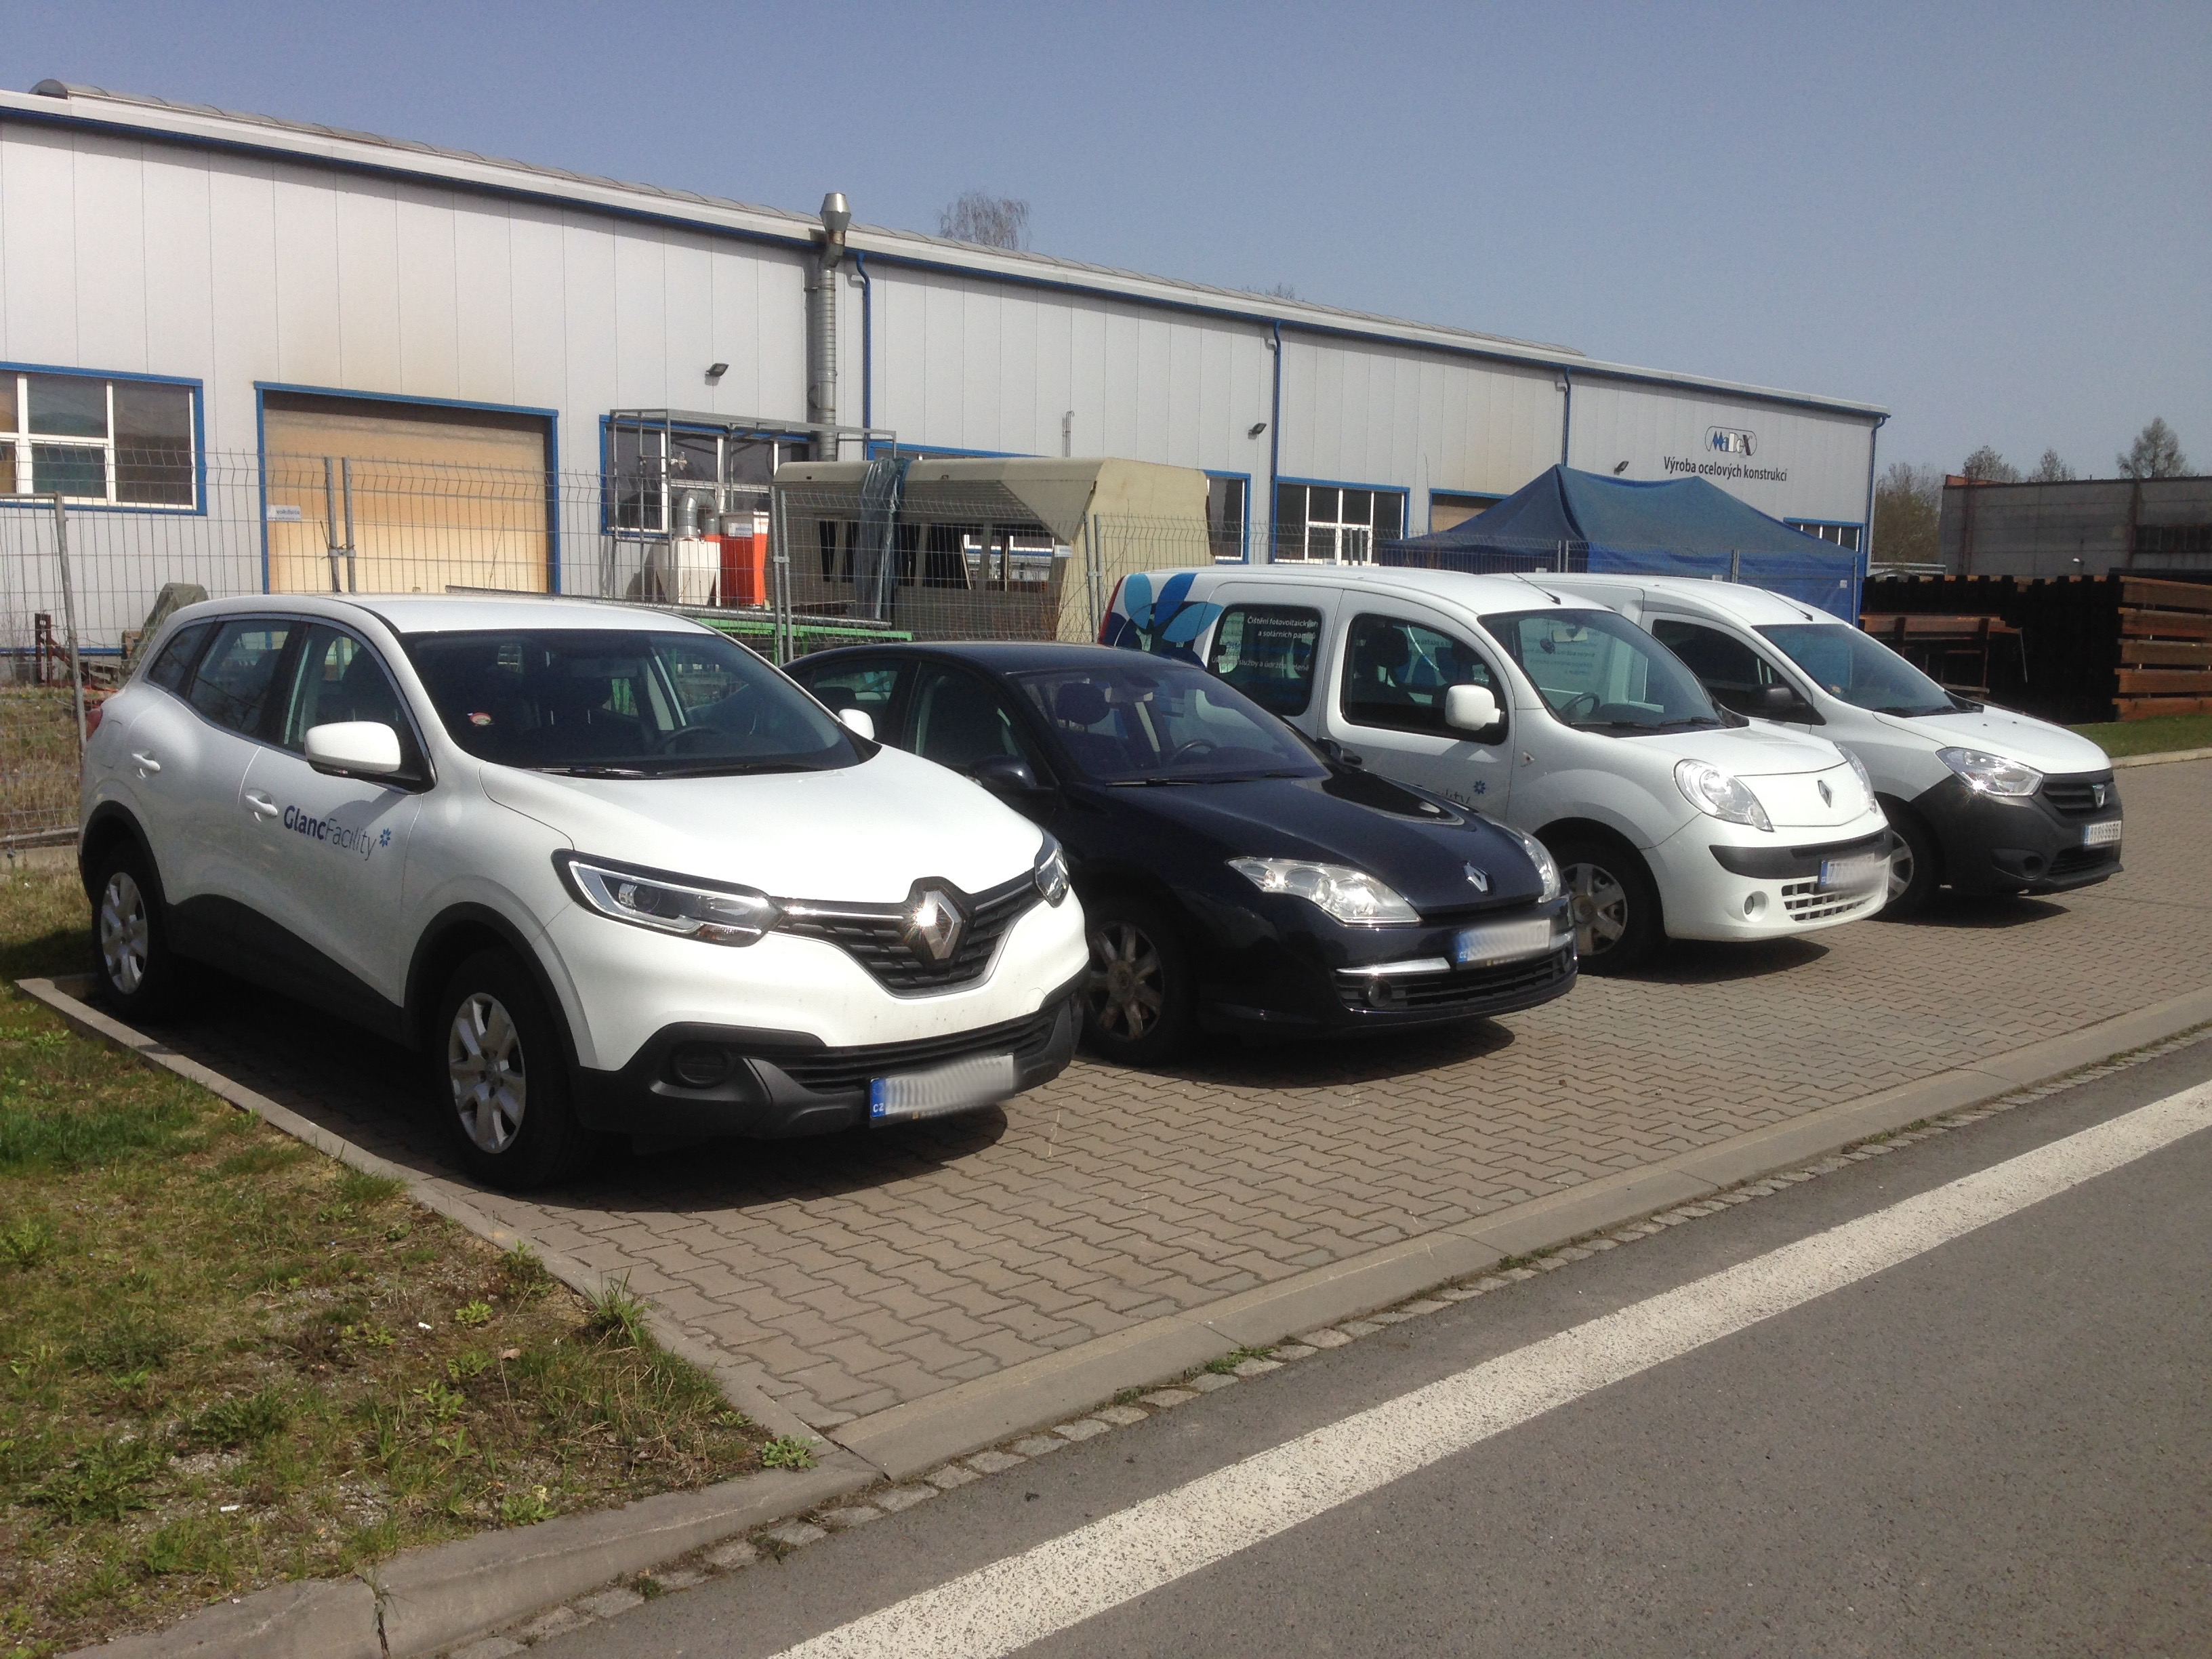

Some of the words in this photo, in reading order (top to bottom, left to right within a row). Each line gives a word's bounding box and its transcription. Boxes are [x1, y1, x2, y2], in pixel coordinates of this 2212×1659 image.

[1664, 455, 1696, 474] Výroba
[1698, 462, 1742, 480] ocelových
[1744, 464, 1788, 482] konstrukcí
[1247, 615, 1269, 625] Čištění
[1263, 630, 1292, 638] solárních
[283, 804, 377, 861] GlancFacility
[872, 1103, 884, 1113] CZ
